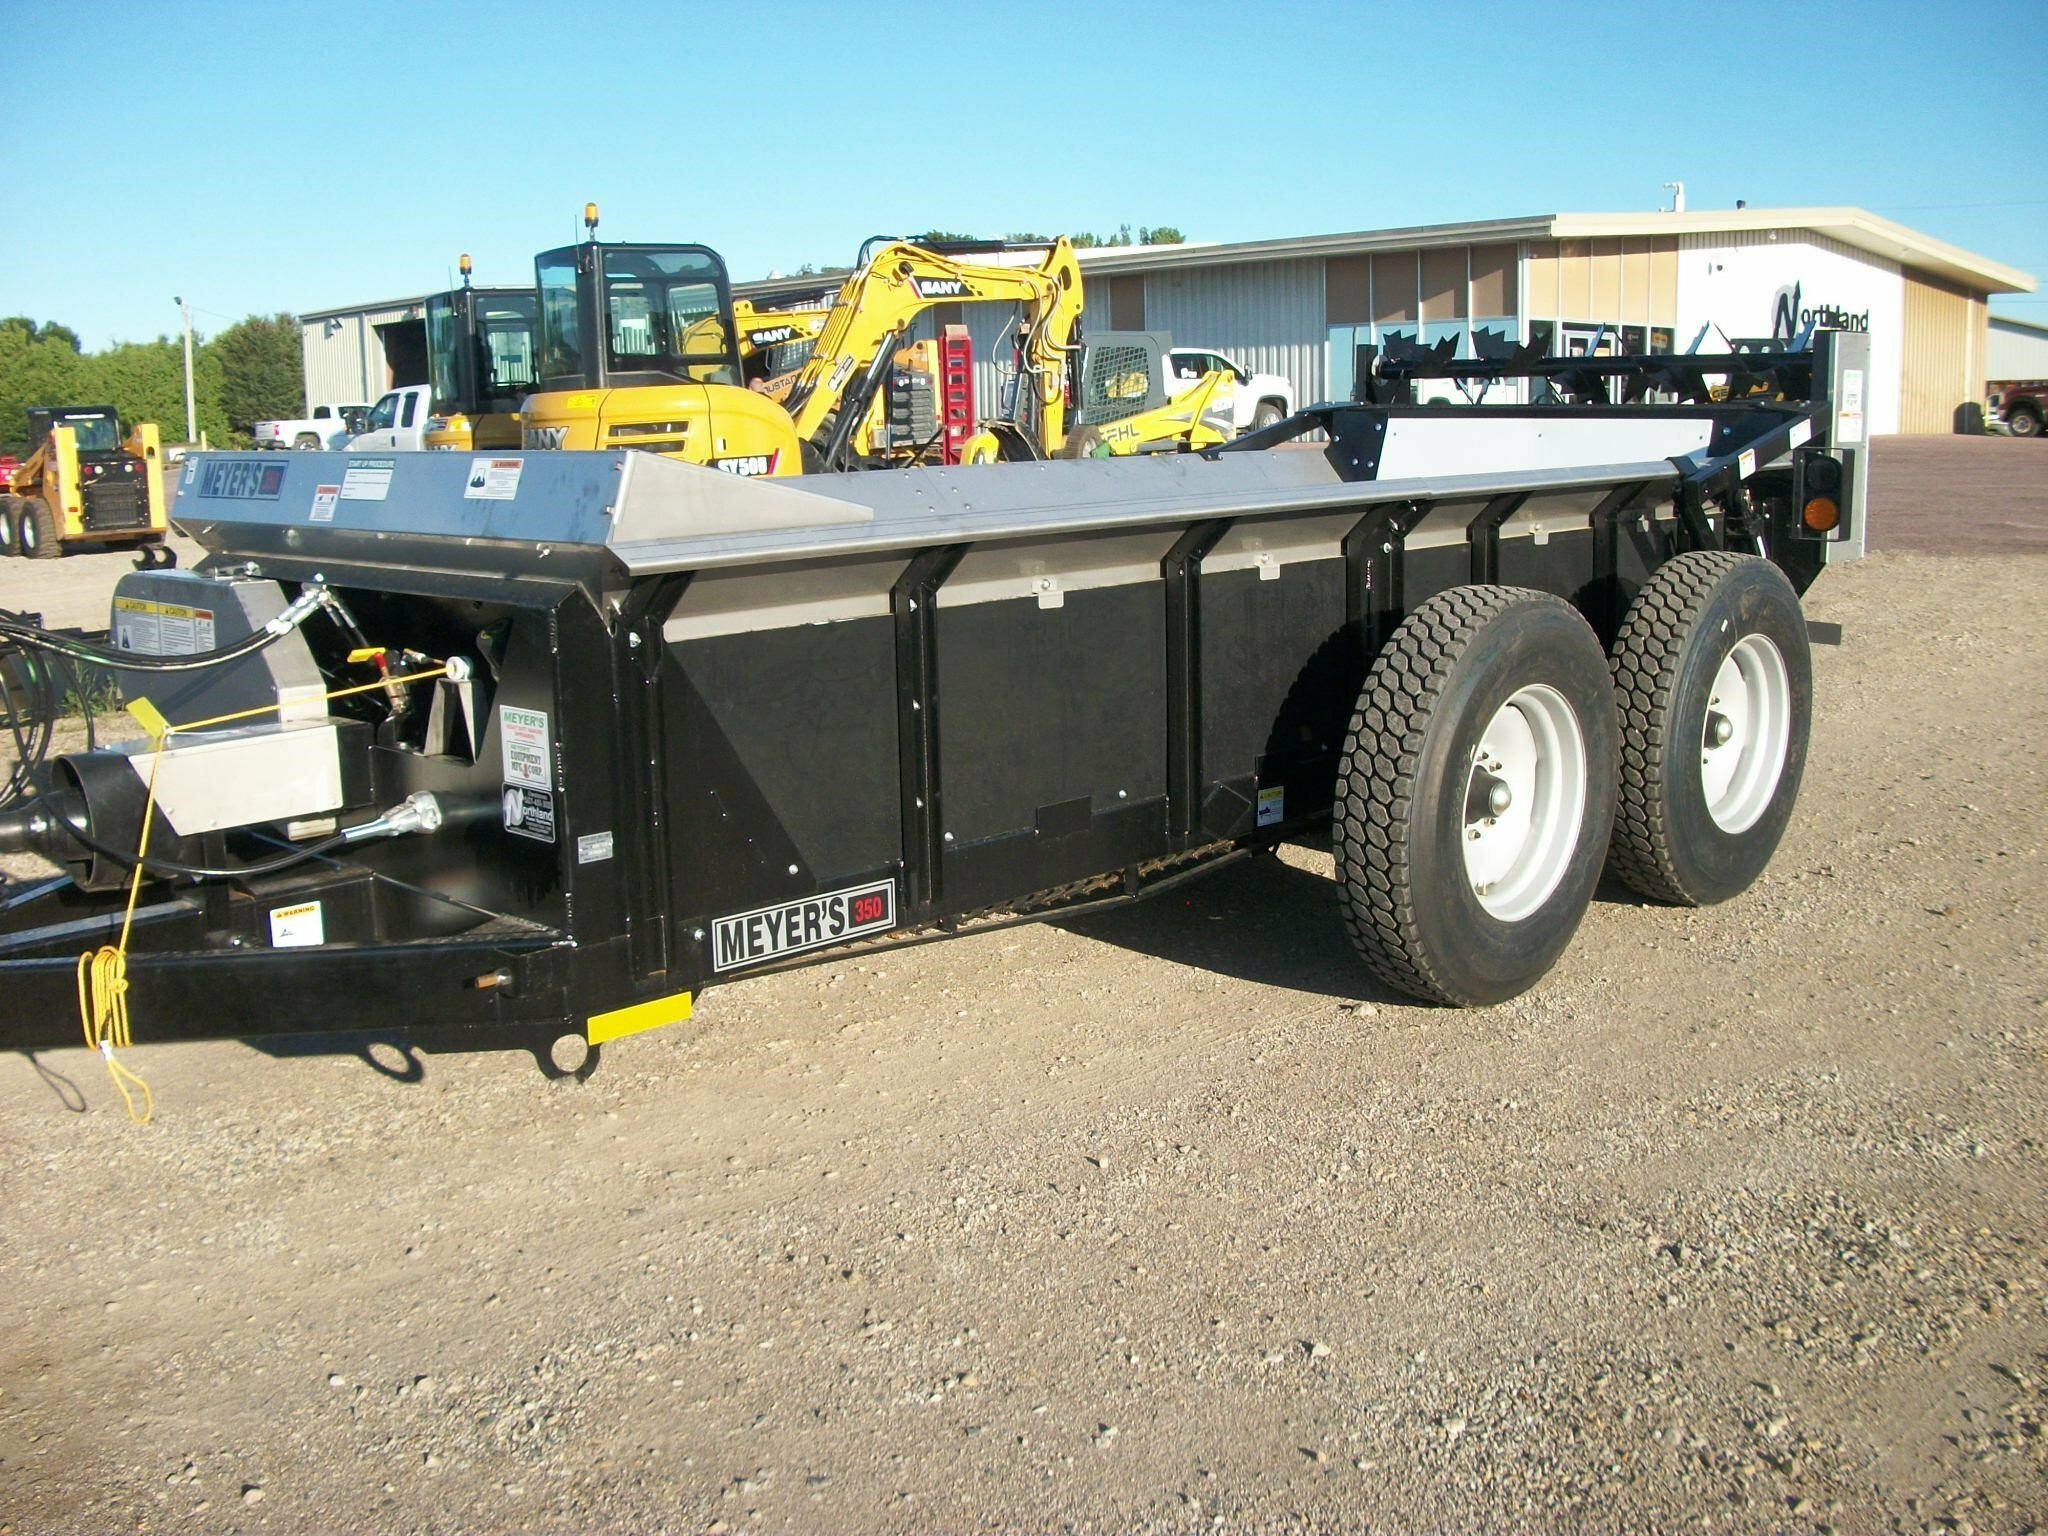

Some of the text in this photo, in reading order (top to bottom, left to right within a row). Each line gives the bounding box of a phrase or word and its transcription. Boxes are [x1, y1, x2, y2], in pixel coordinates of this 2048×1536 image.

[921, 281, 961, 294] SANY
[1772, 280, 1869, 338] Northland
[752, 327, 791, 344] SANY
[200, 462, 263, 497] MEYER'S
[503, 711, 545, 728] MEYER'S
[283, 906, 315, 915] WARNING
[720, 896, 882, 963] MEYER'S 350
